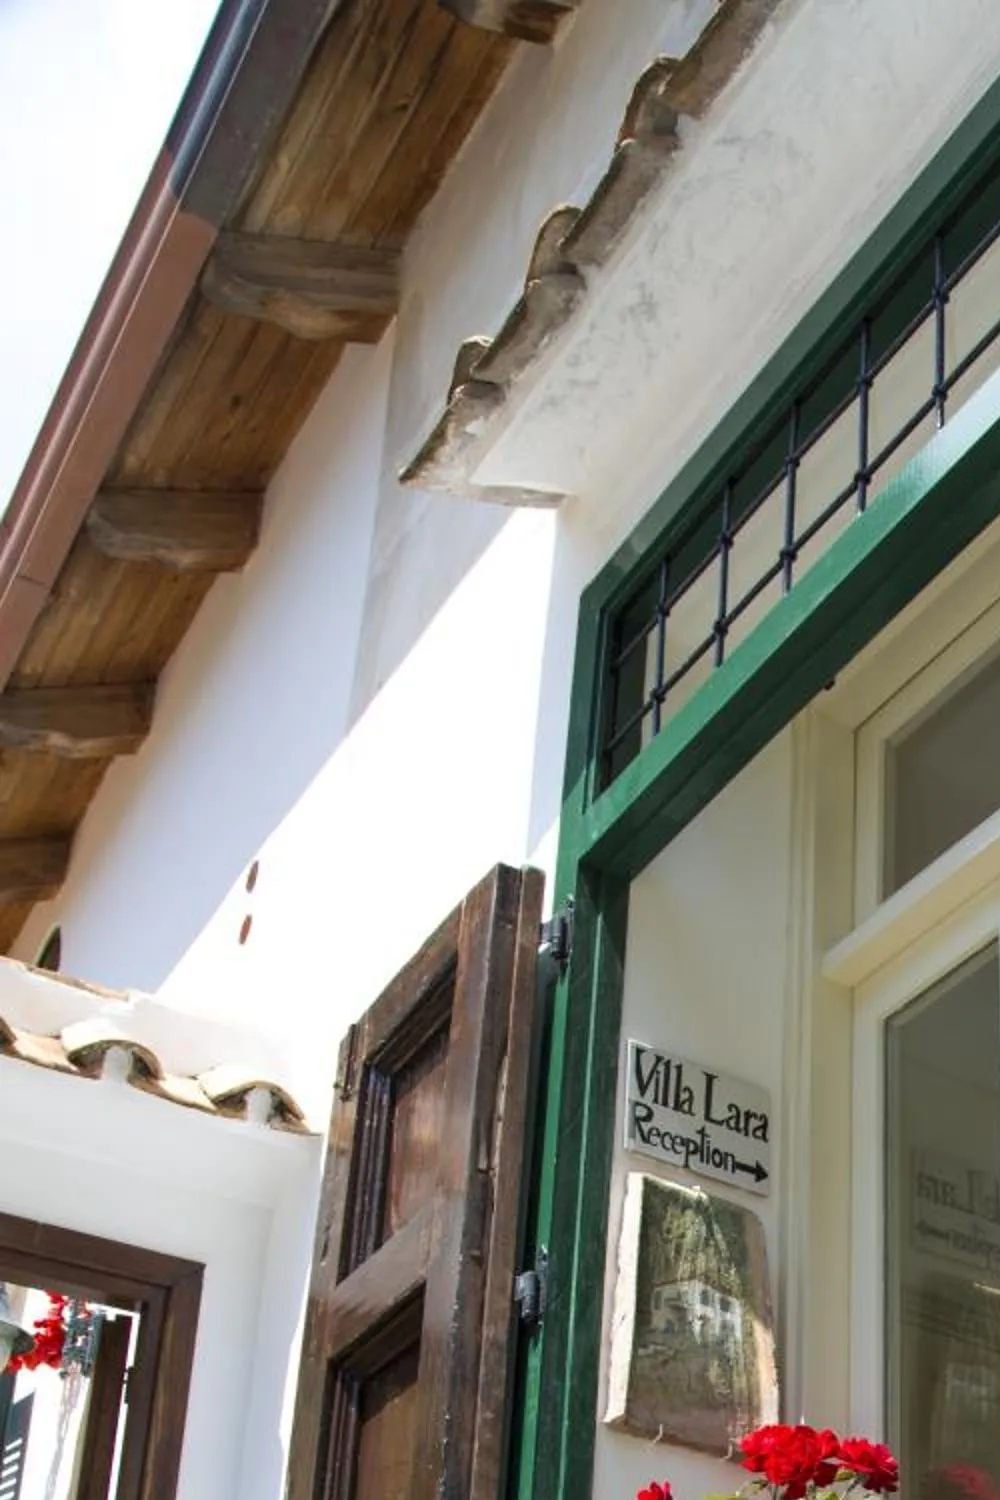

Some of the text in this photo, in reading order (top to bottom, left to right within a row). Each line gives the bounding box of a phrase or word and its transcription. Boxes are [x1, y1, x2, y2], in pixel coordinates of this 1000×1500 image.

[635, 1046, 769, 1143] Villa Lara
[634, 1101, 737, 1174] Reception
